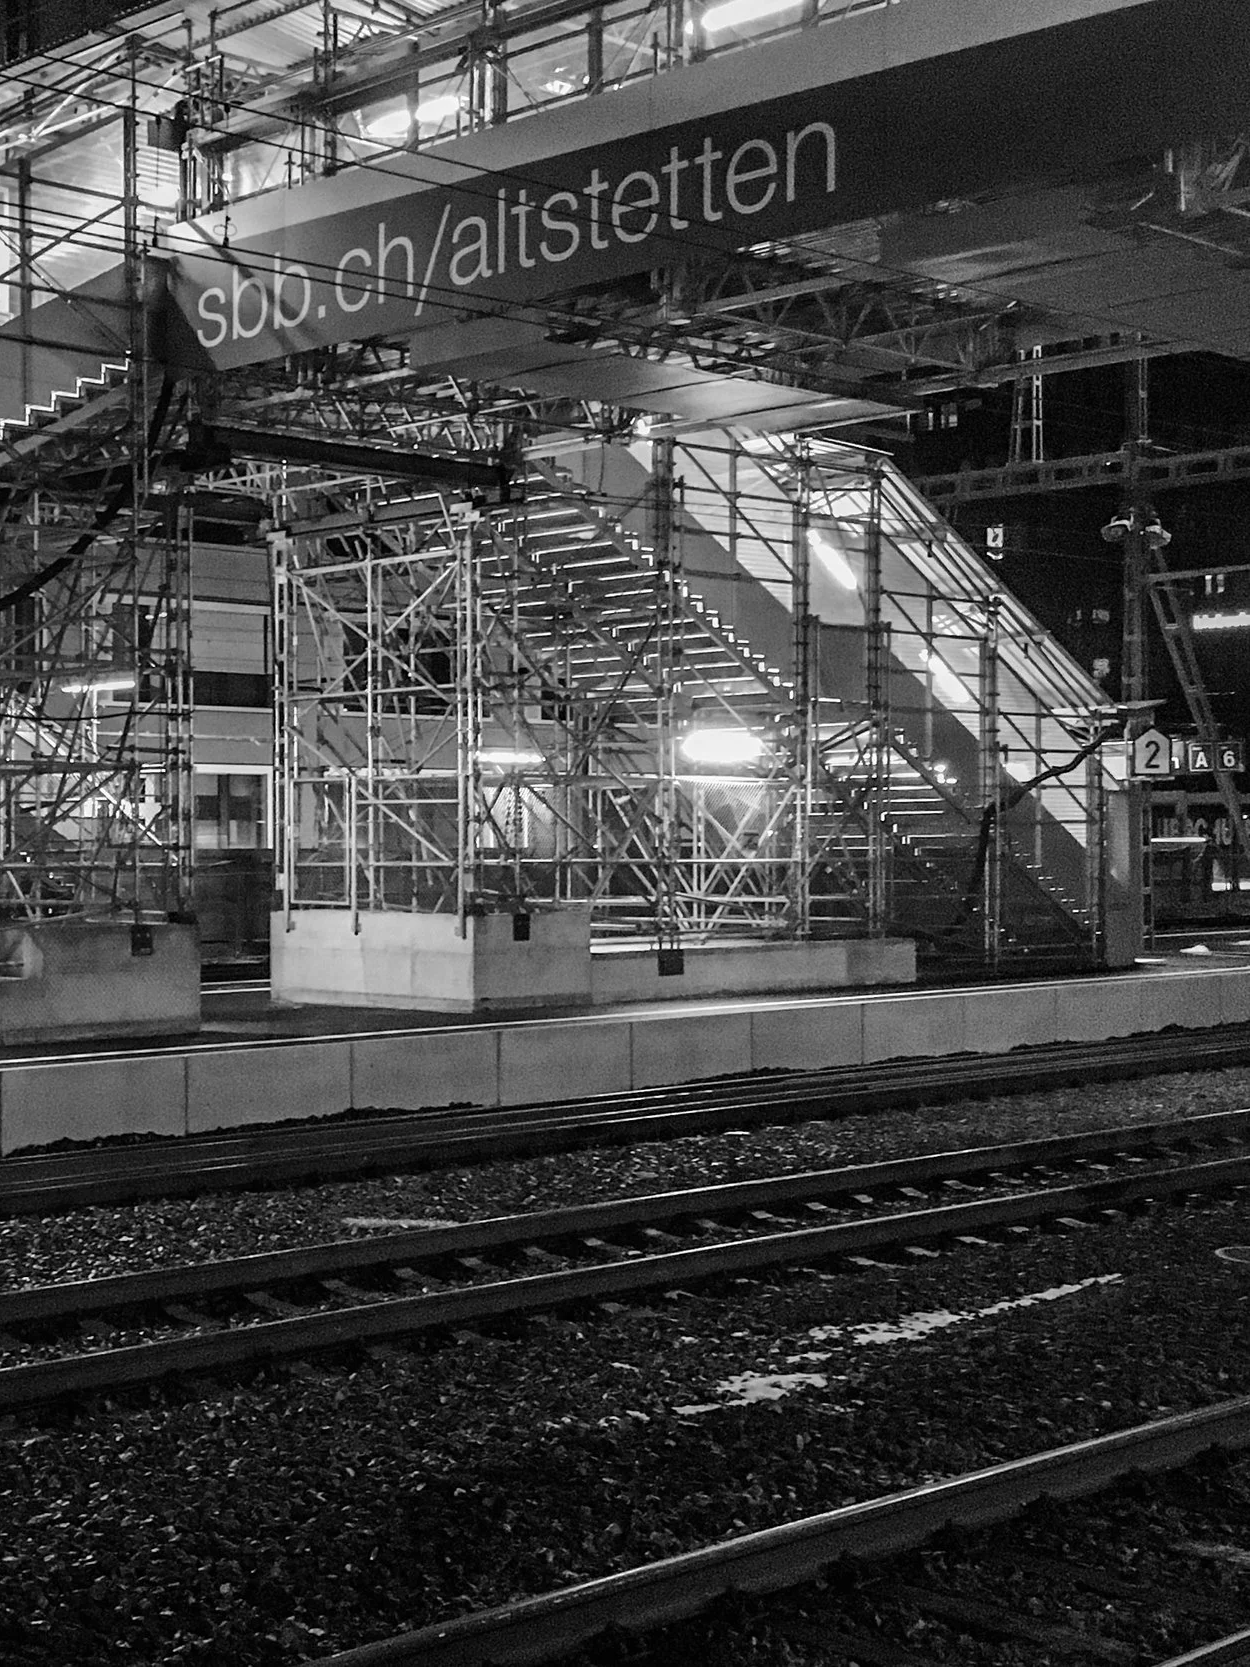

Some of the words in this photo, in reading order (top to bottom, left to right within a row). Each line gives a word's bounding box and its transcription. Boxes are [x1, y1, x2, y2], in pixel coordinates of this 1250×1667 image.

[196, 118, 837, 349] sbb.ch/altstetten
[1145, 741, 1160, 768] 2
[1195, 752, 1208, 768] A
[1223, 751, 1235, 767] 6
